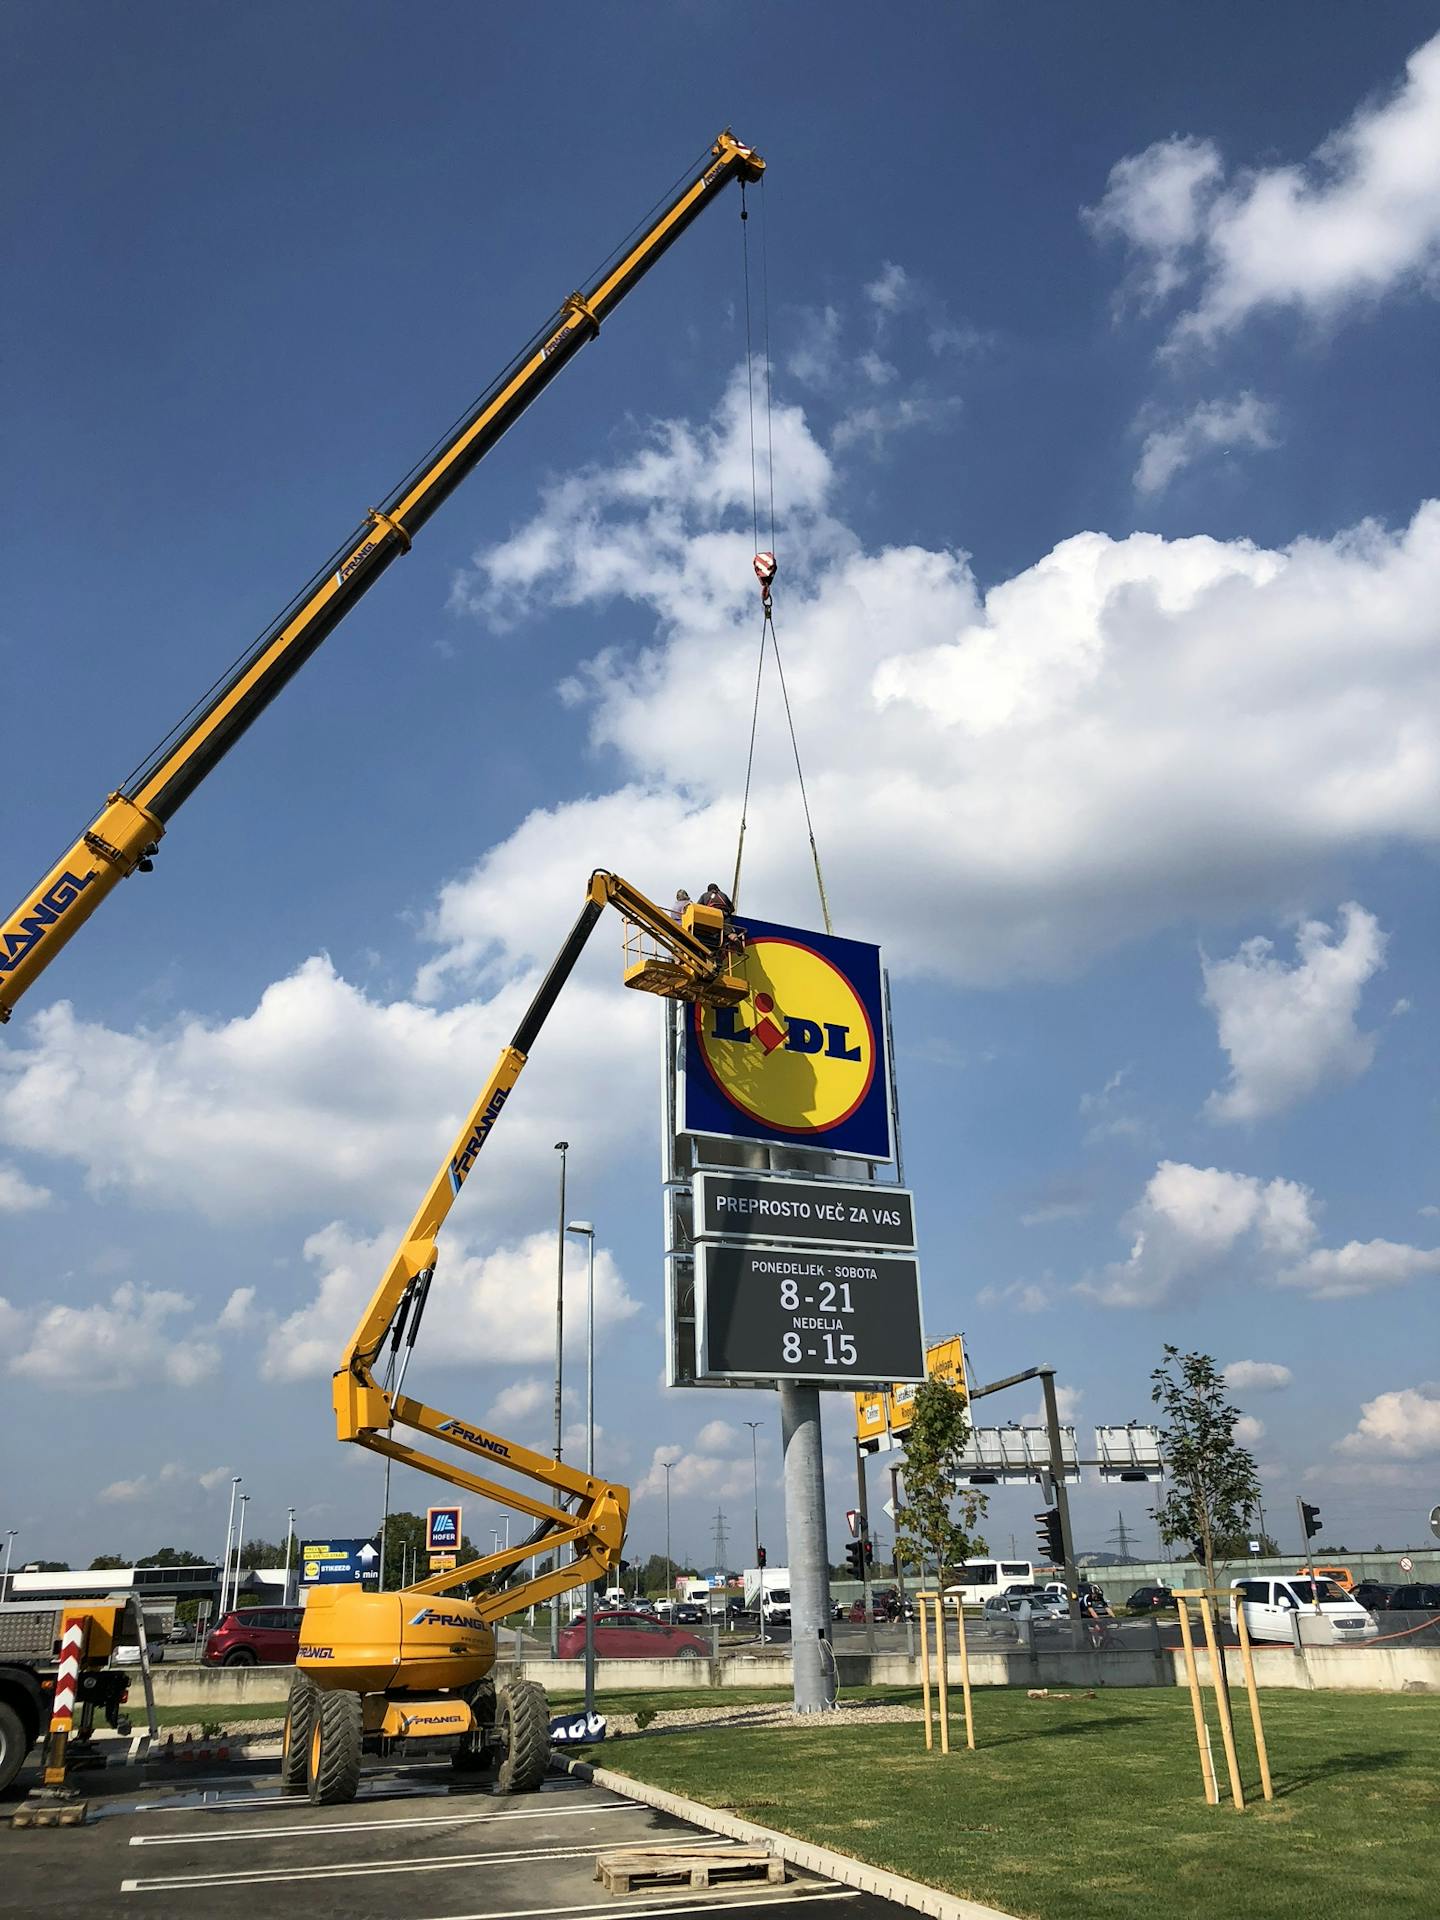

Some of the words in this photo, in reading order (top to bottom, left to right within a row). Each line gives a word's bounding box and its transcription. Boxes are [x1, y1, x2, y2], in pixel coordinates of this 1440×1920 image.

[0, 870, 97, 984] ANGL
[451, 1087, 511, 1183] PRANGL
[717, 1195, 810, 1219] PREPROSTO
[815, 1202, 845, 1222] VEČ
[850, 1206, 869, 1224] ZA
[873, 1209, 901, 1226] VAS
[752, 1260, 825, 1277] PONEDELJEK
[835, 1266, 877, 1280] SOBOTA
[793, 1317, 843, 1331] NEDELJA
[446, 1421, 512, 1459] PRANGL
[432, 1533, 456, 1541] HOFER
[354, 1570, 361, 1579] 5
[362, 1570, 378, 1579] min
[420, 1612, 489, 1632] PRANGL
[413, 1714, 465, 1725] PRANGL
